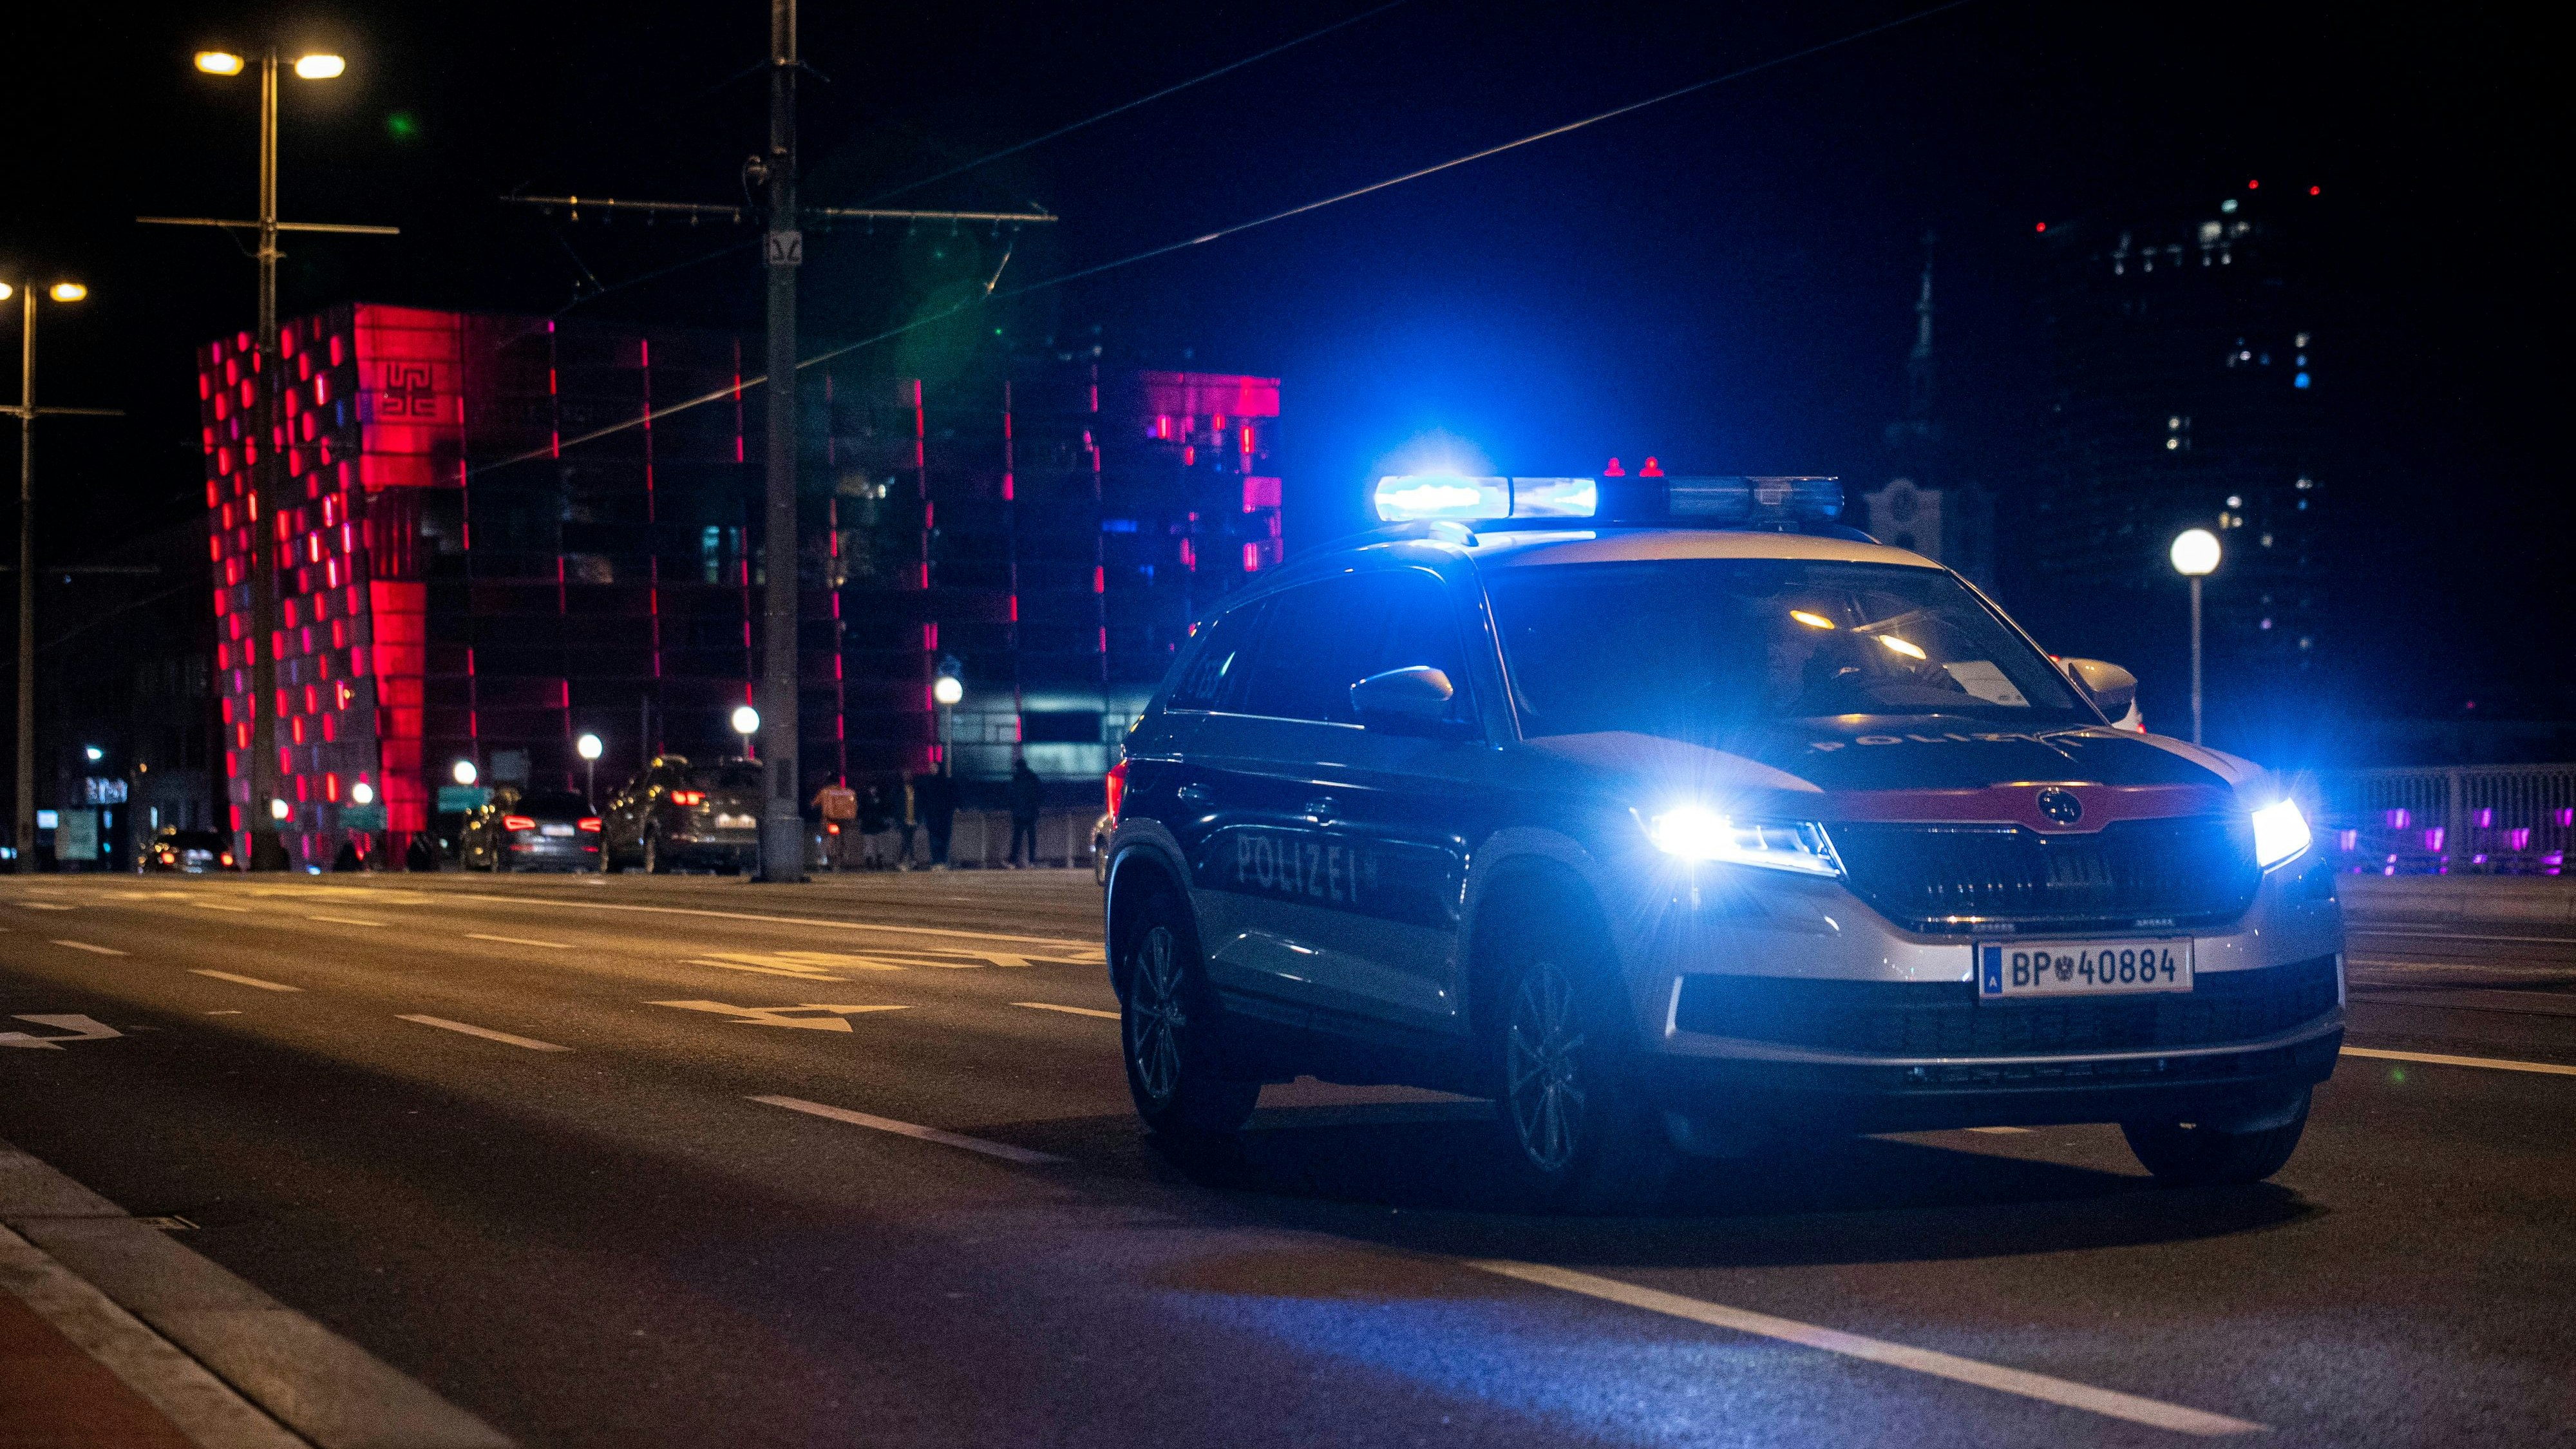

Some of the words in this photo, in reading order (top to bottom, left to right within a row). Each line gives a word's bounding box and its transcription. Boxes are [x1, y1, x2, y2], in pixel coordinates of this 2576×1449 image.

[1236, 833, 1357, 902] POLIZEI
[1989, 976, 1998, 988] A
[2012, 951, 2051, 987] BP
[2078, 949, 2176, 985] 40884
